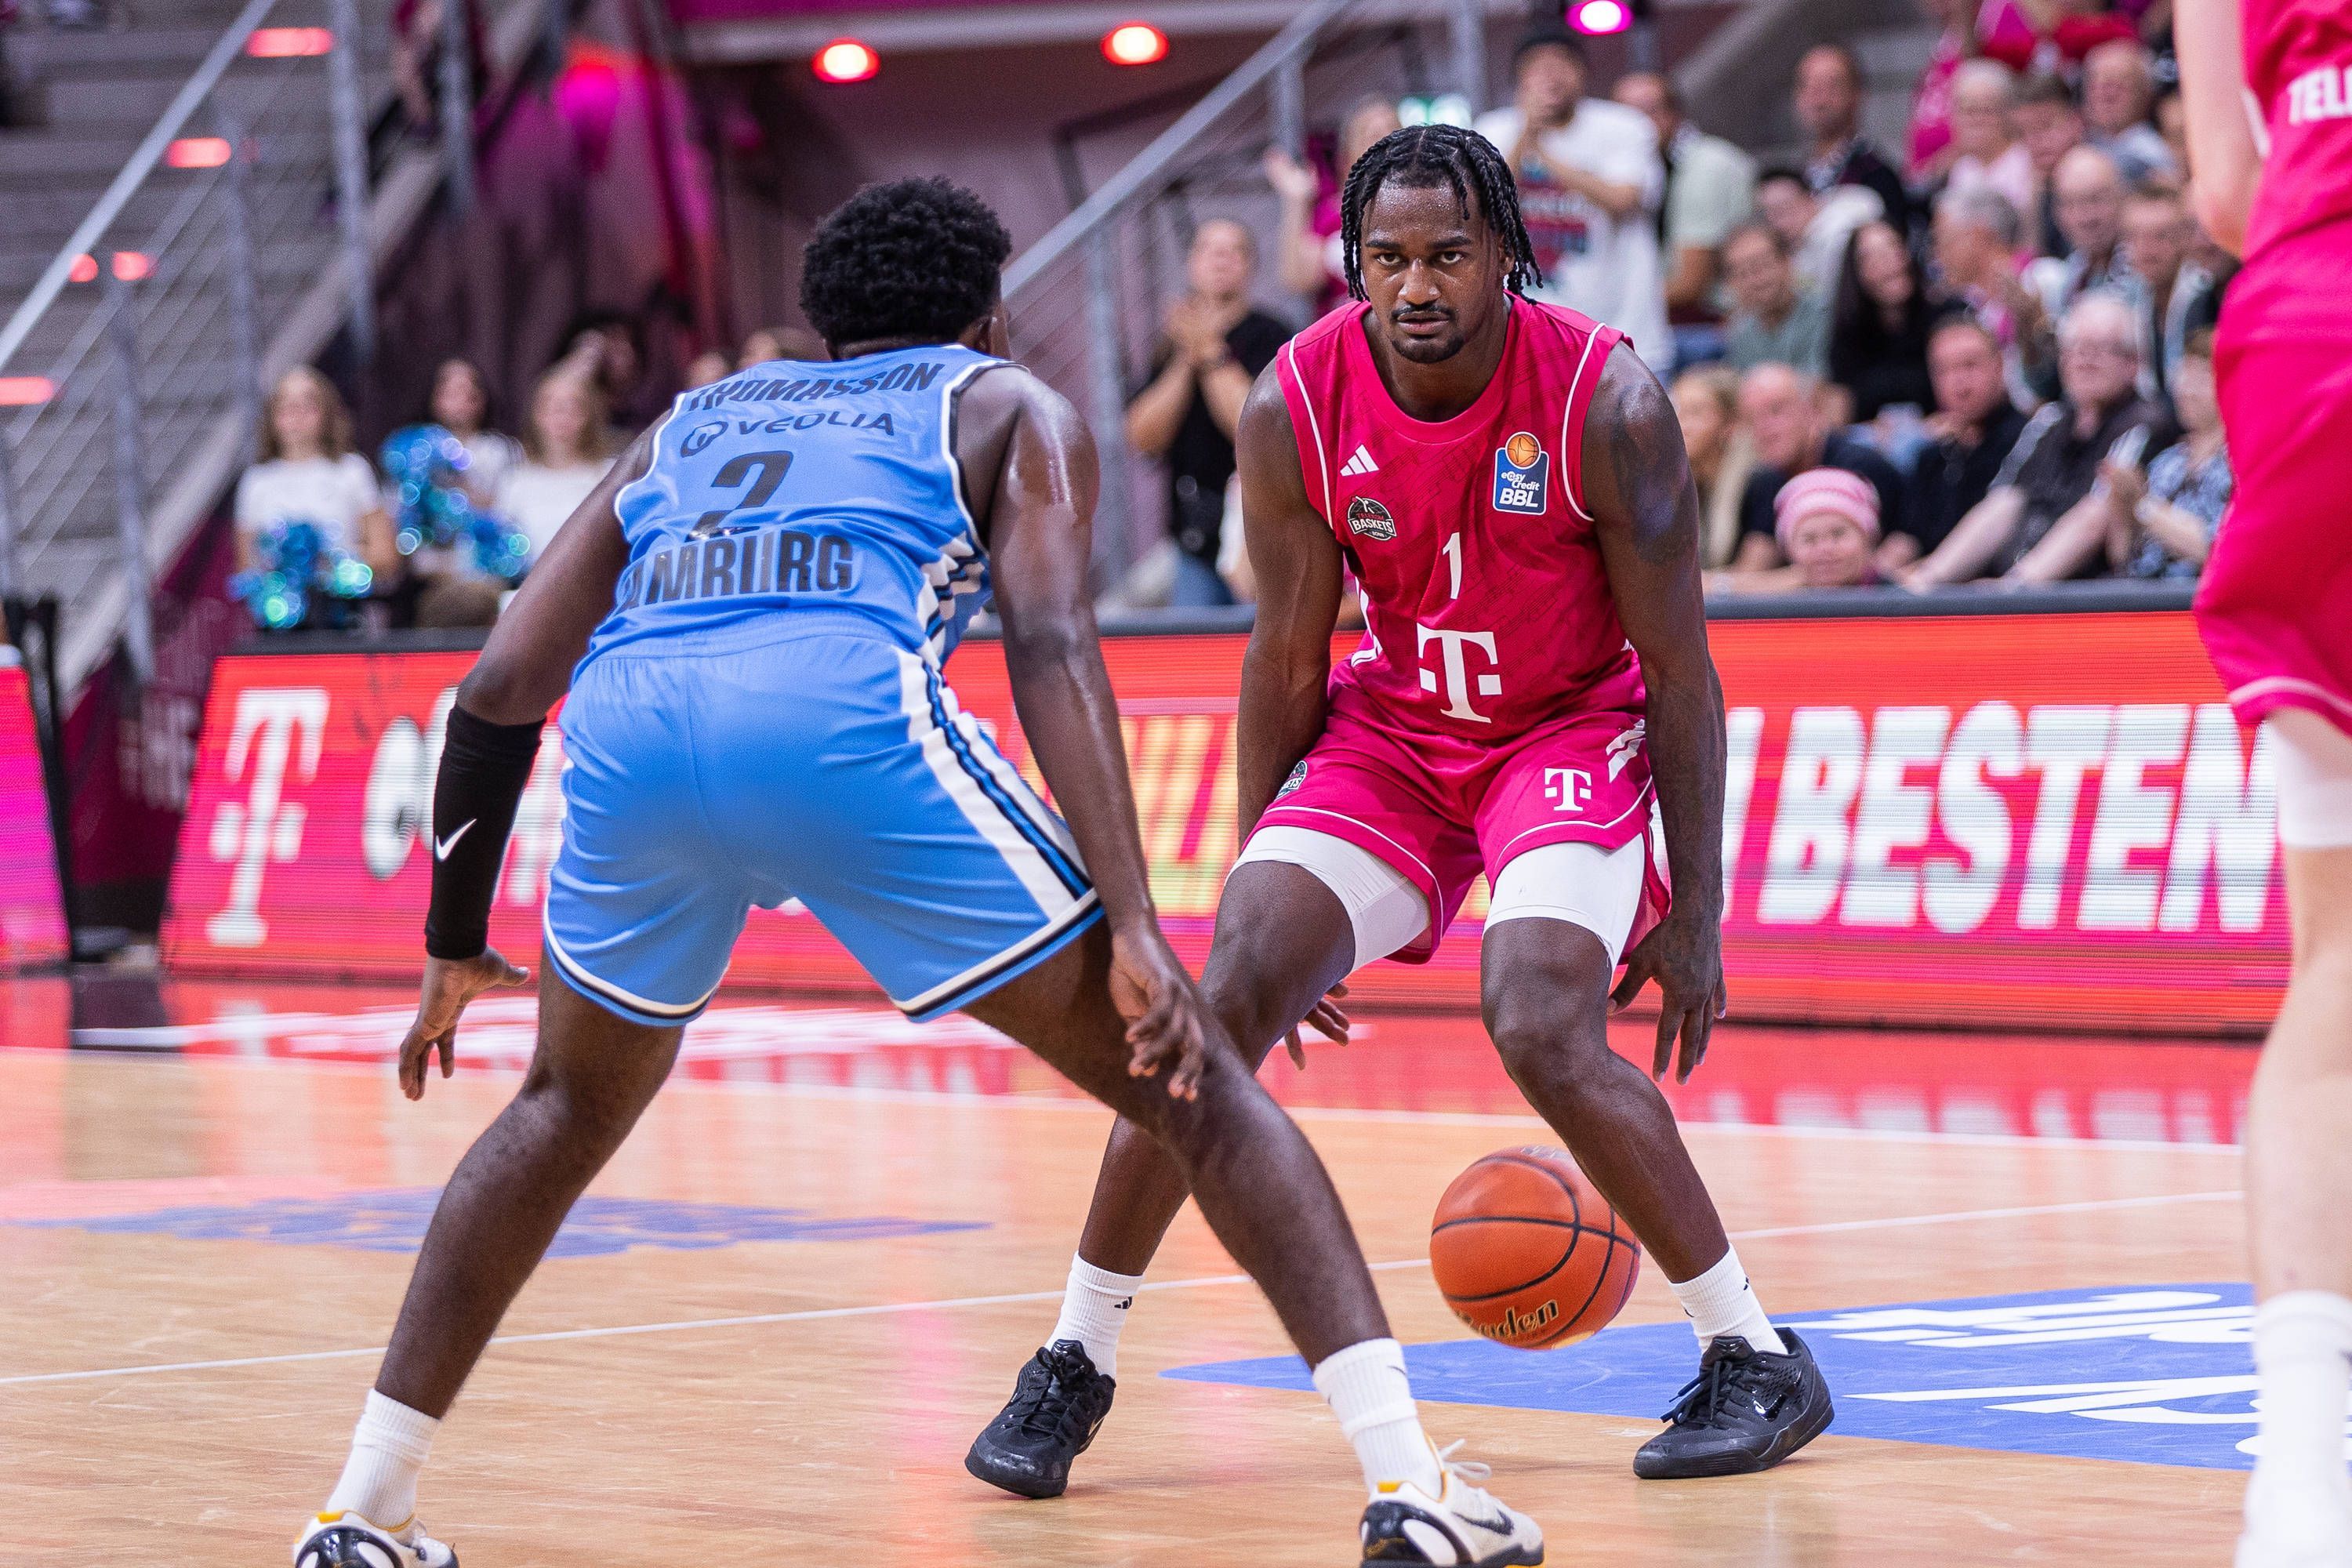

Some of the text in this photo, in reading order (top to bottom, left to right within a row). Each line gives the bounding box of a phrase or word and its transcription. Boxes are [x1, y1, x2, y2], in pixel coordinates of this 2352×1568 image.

[689, 362, 946, 411] THOMASSON
[738, 410, 895, 437] VEOLIA
[688, 450, 794, 542] 2
[1498, 487, 1539, 508] BBL
[1511, 479, 1541, 492] Credit
[1351, 517, 1394, 534] BASKETS
[1442, 531, 1463, 601] 1
[1416, 622, 1503, 724] T
[1756, 700, 2278, 934] BESTEN
[1456, 1299, 1559, 1339] den
